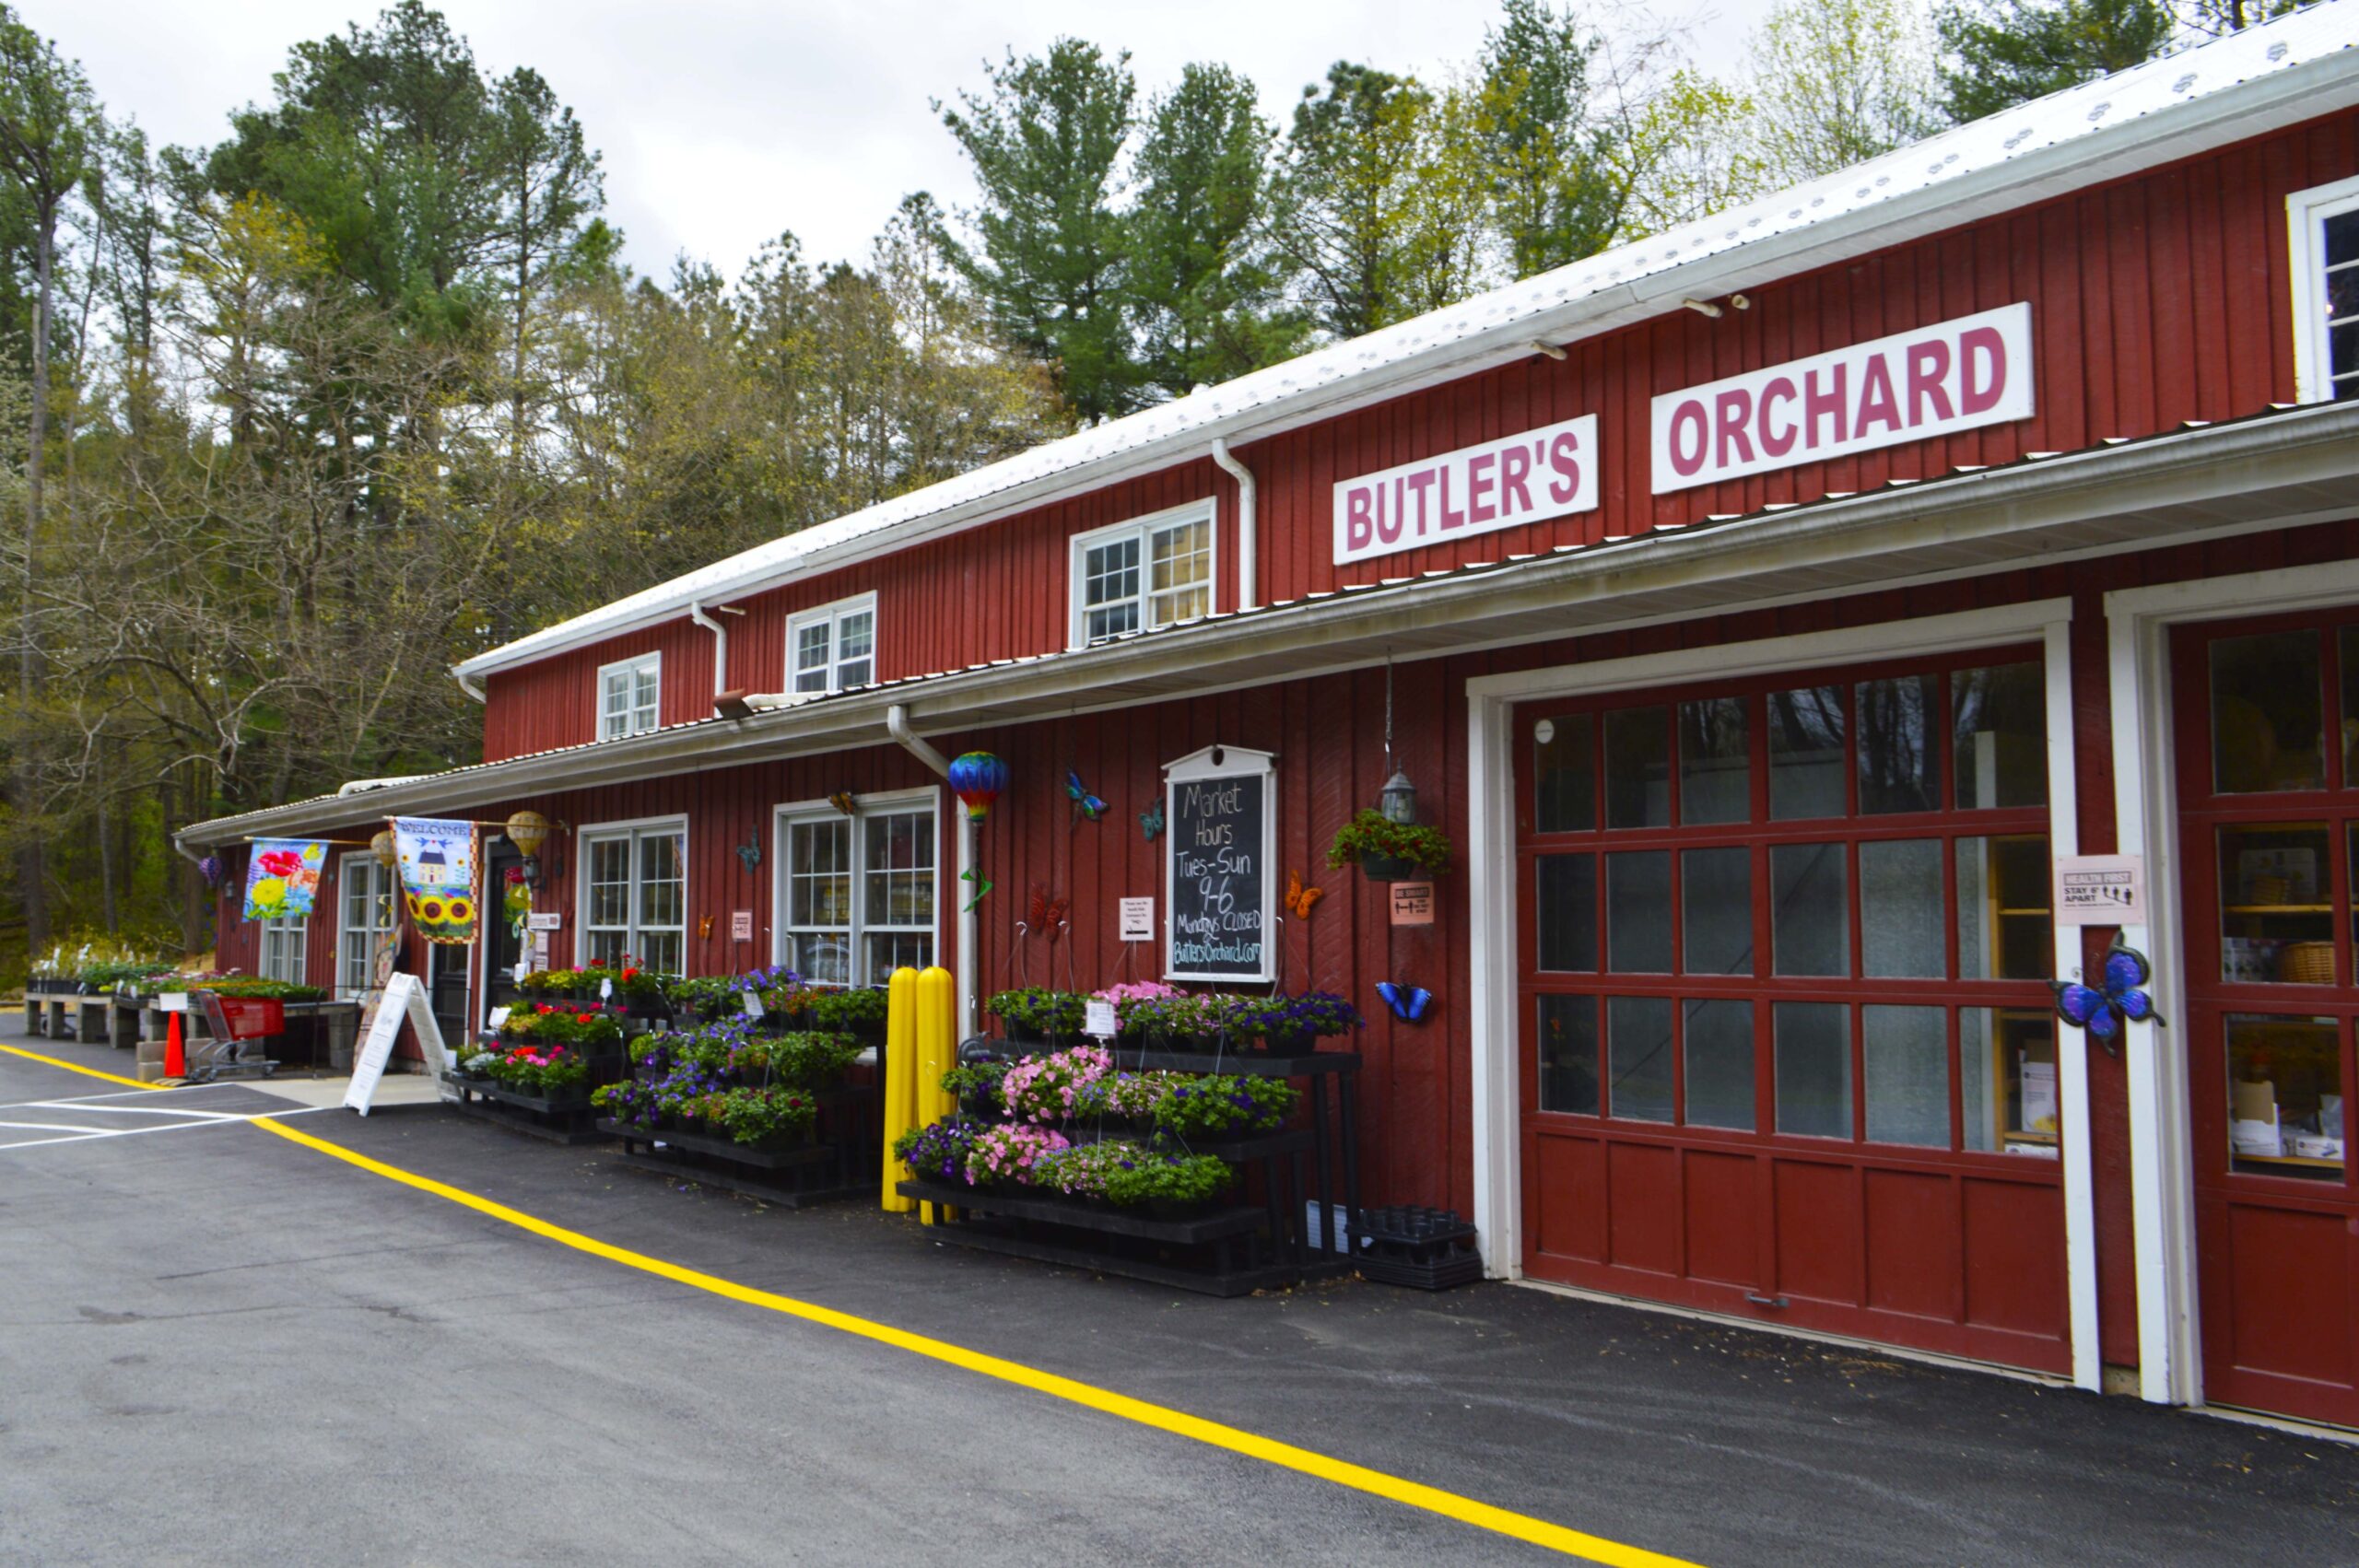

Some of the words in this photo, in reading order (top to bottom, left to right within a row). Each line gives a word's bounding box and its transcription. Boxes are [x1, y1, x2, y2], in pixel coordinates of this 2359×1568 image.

[1347, 431, 1580, 553] BUTLER'S
[1669, 326, 2007, 477] ORCHARD
[1182, 783, 1243, 818] Market
[400, 822, 467, 836] WELCOME
[1195, 819, 1233, 847] Hours
[1176, 847, 1251, 877] Tues-Sun
[1199, 876, 1235, 915] 9-6
[1222, 909, 1262, 932] CLOSED
